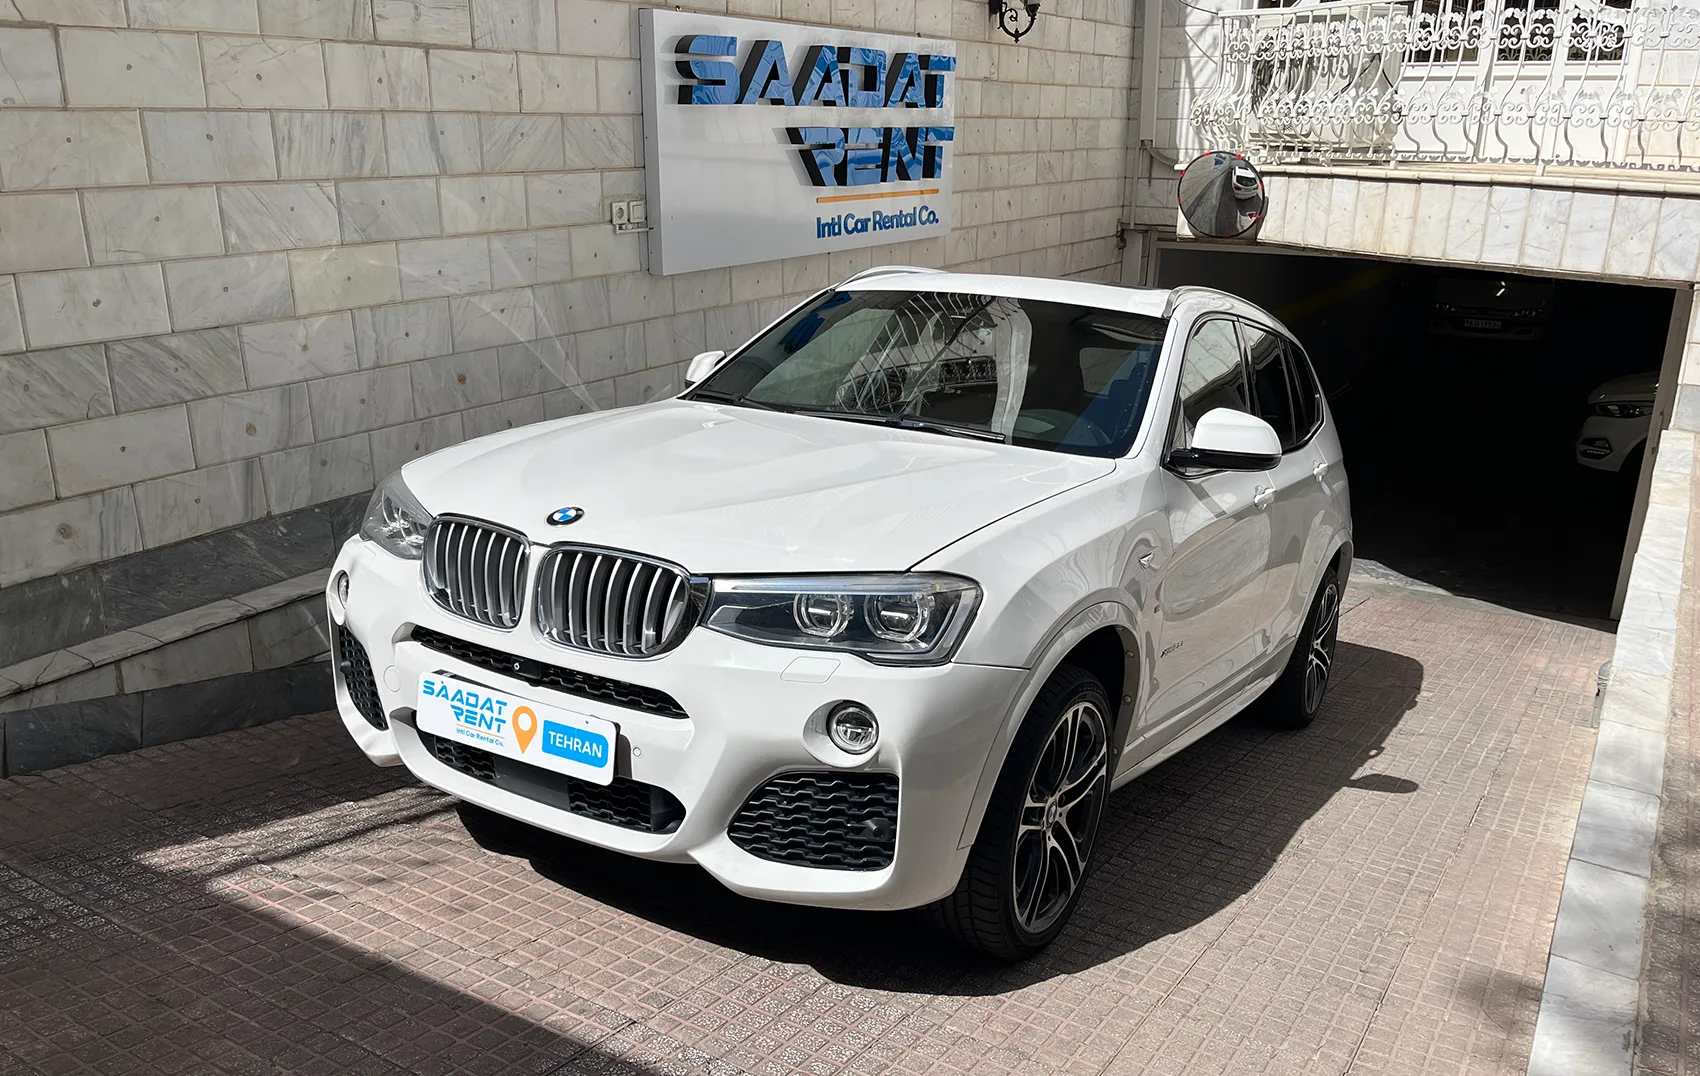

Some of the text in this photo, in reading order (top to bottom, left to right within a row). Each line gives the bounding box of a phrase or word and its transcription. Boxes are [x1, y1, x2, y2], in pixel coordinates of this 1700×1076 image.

[674, 35, 957, 108] SAADAT
[786, 127, 955, 187] RENT
[843, 213, 871, 235] Car
[872, 206, 917, 231] Rental
[918, 205, 939, 226] Co.
[423, 679, 507, 715] SAADAT
[450, 704, 506, 733] RENT
[466, 730, 475, 739] Car
[476, 733, 494, 744] Rental
[548, 731, 602, 758] TEHRAN
